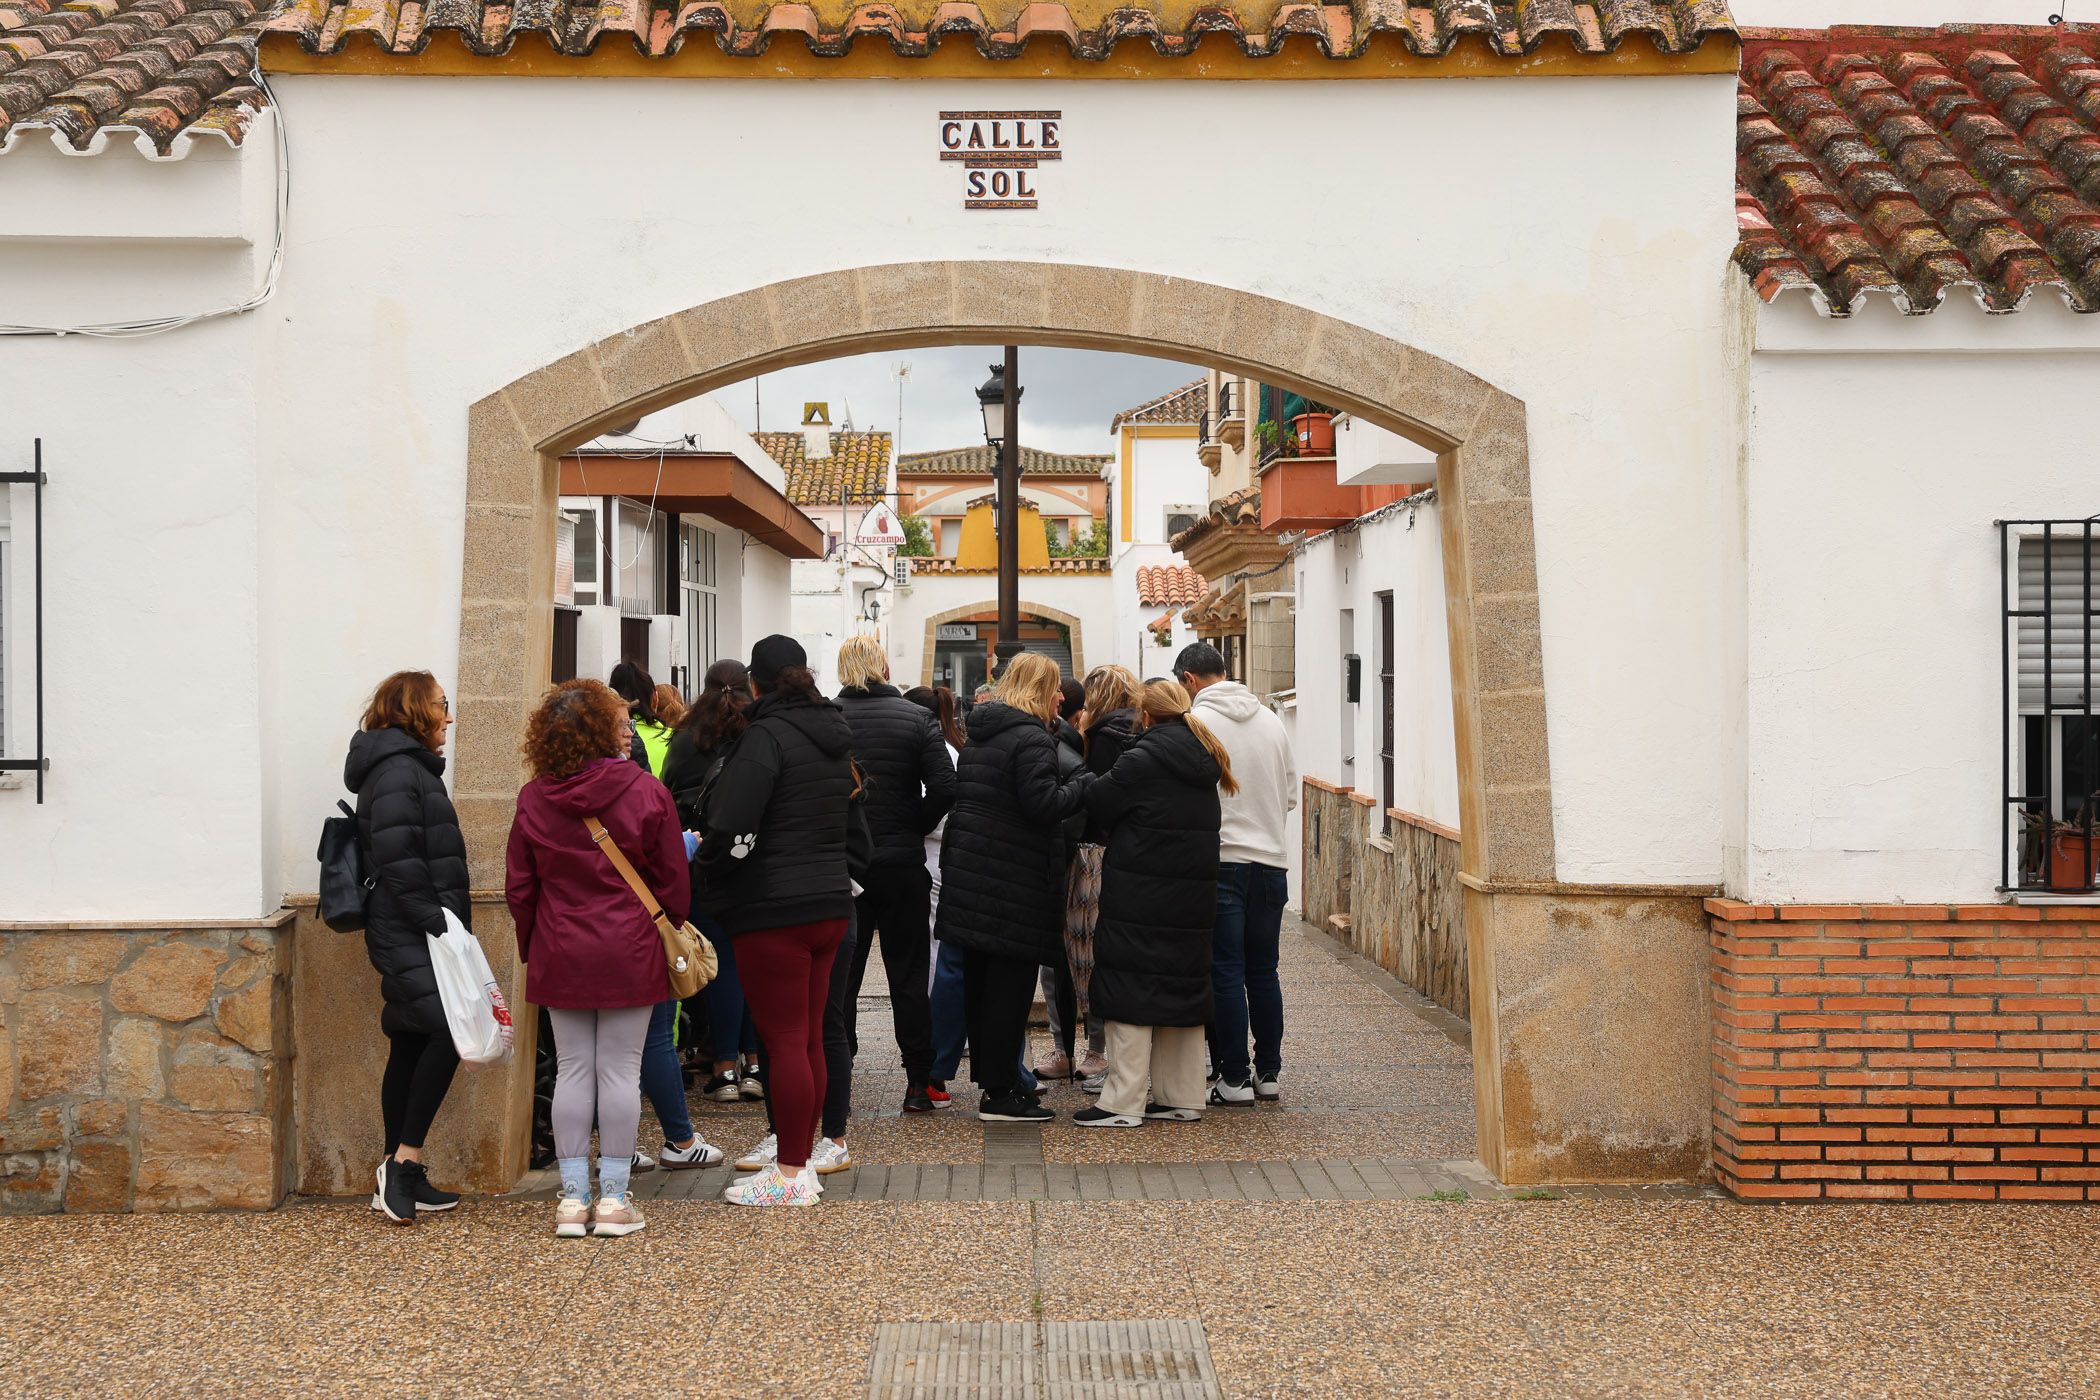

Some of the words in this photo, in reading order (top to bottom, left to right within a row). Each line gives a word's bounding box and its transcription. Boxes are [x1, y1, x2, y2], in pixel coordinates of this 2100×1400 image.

[942, 121, 1060, 149] CALLE
[967, 170, 1036, 198] SOL
[857, 535, 905, 544] Cruzcampo
